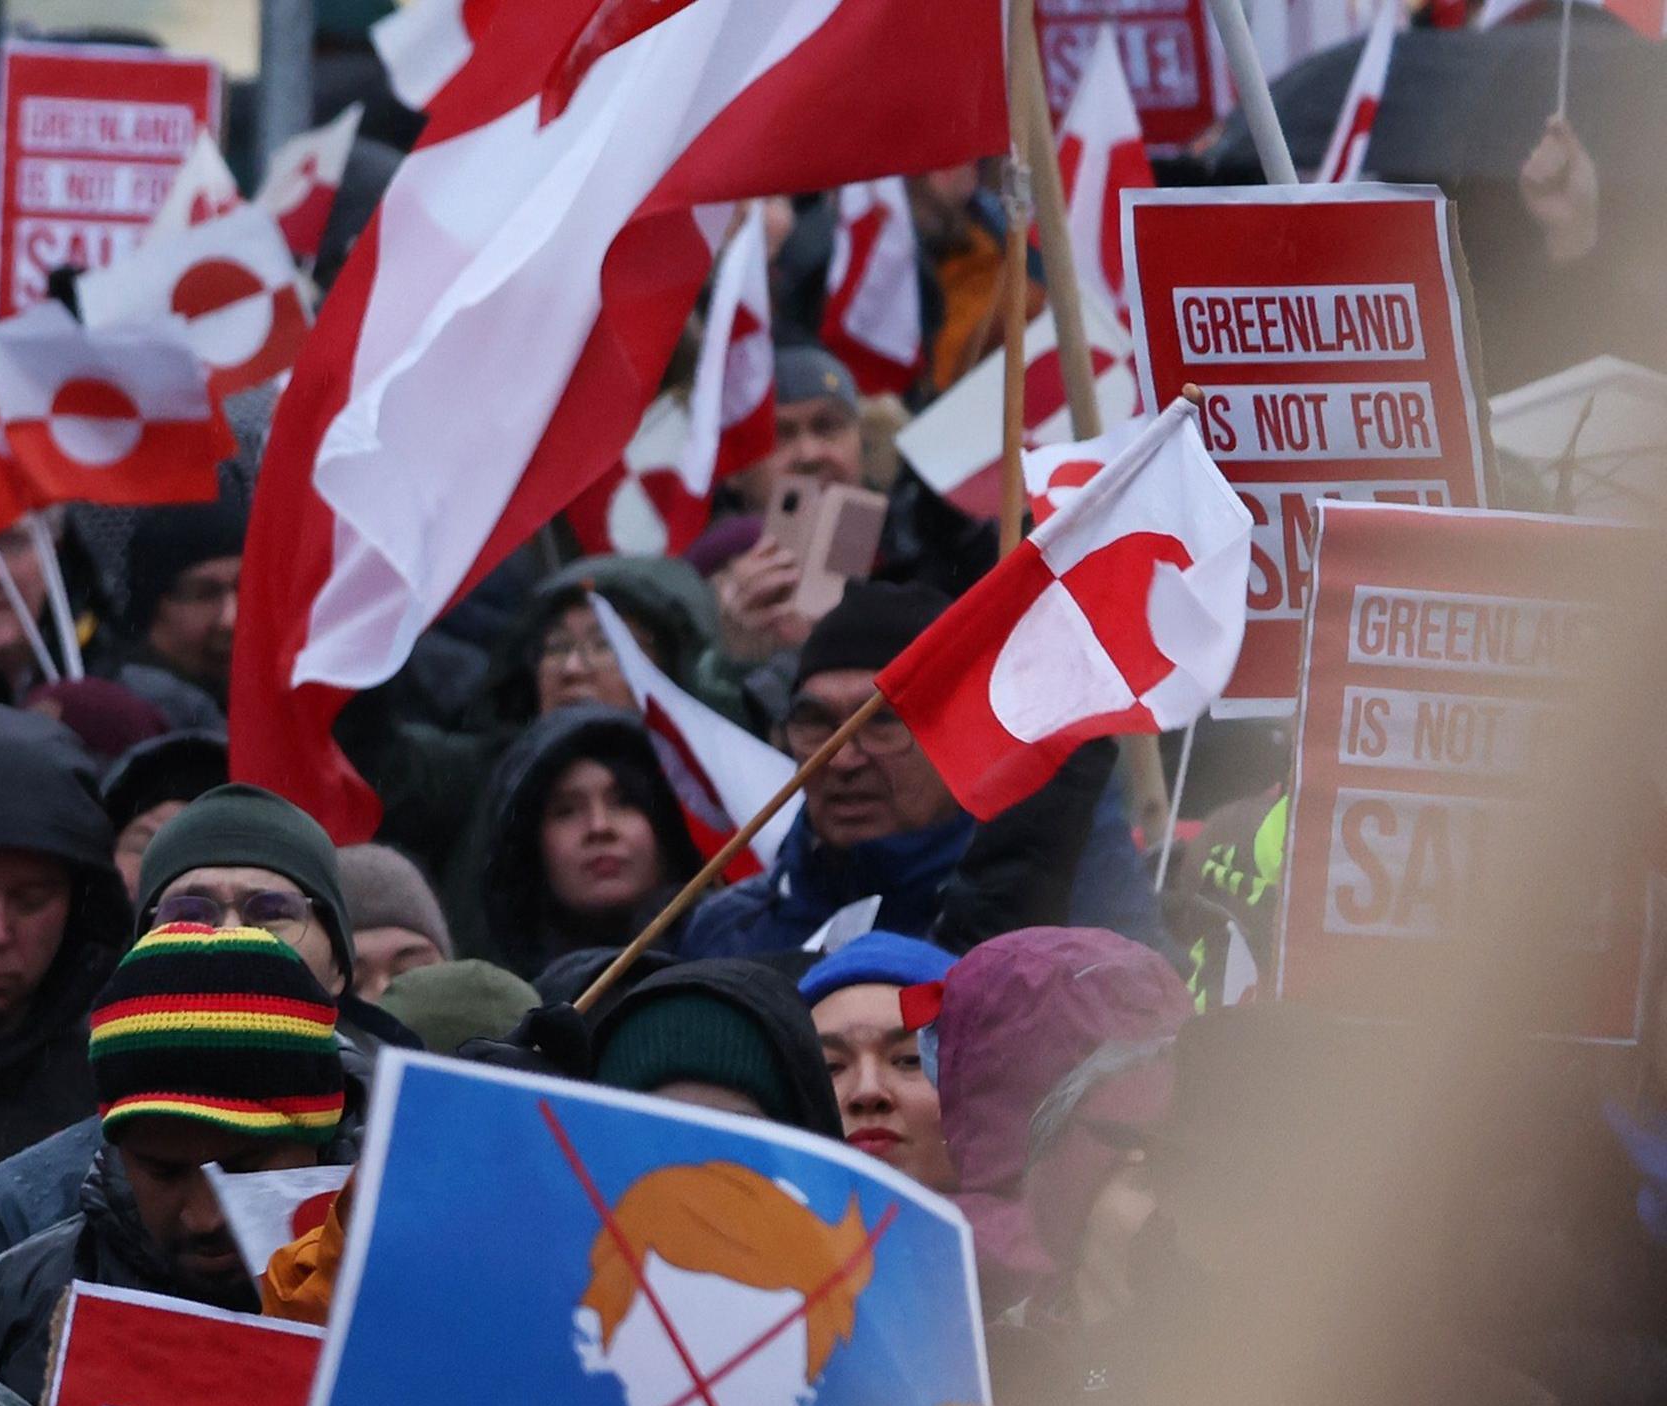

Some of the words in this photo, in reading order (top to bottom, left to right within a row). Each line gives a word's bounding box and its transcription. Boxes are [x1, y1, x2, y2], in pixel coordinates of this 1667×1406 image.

[1182, 294, 1415, 355] GREENLAND
[1199, 393, 1237, 452] IS
[1253, 393, 1328, 451] NOT
[1351, 391, 1431, 449] FOR
[1357, 596, 1565, 665] GREENLA
[1347, 696, 1390, 758] IS
[1414, 702, 1506, 764] NOT
